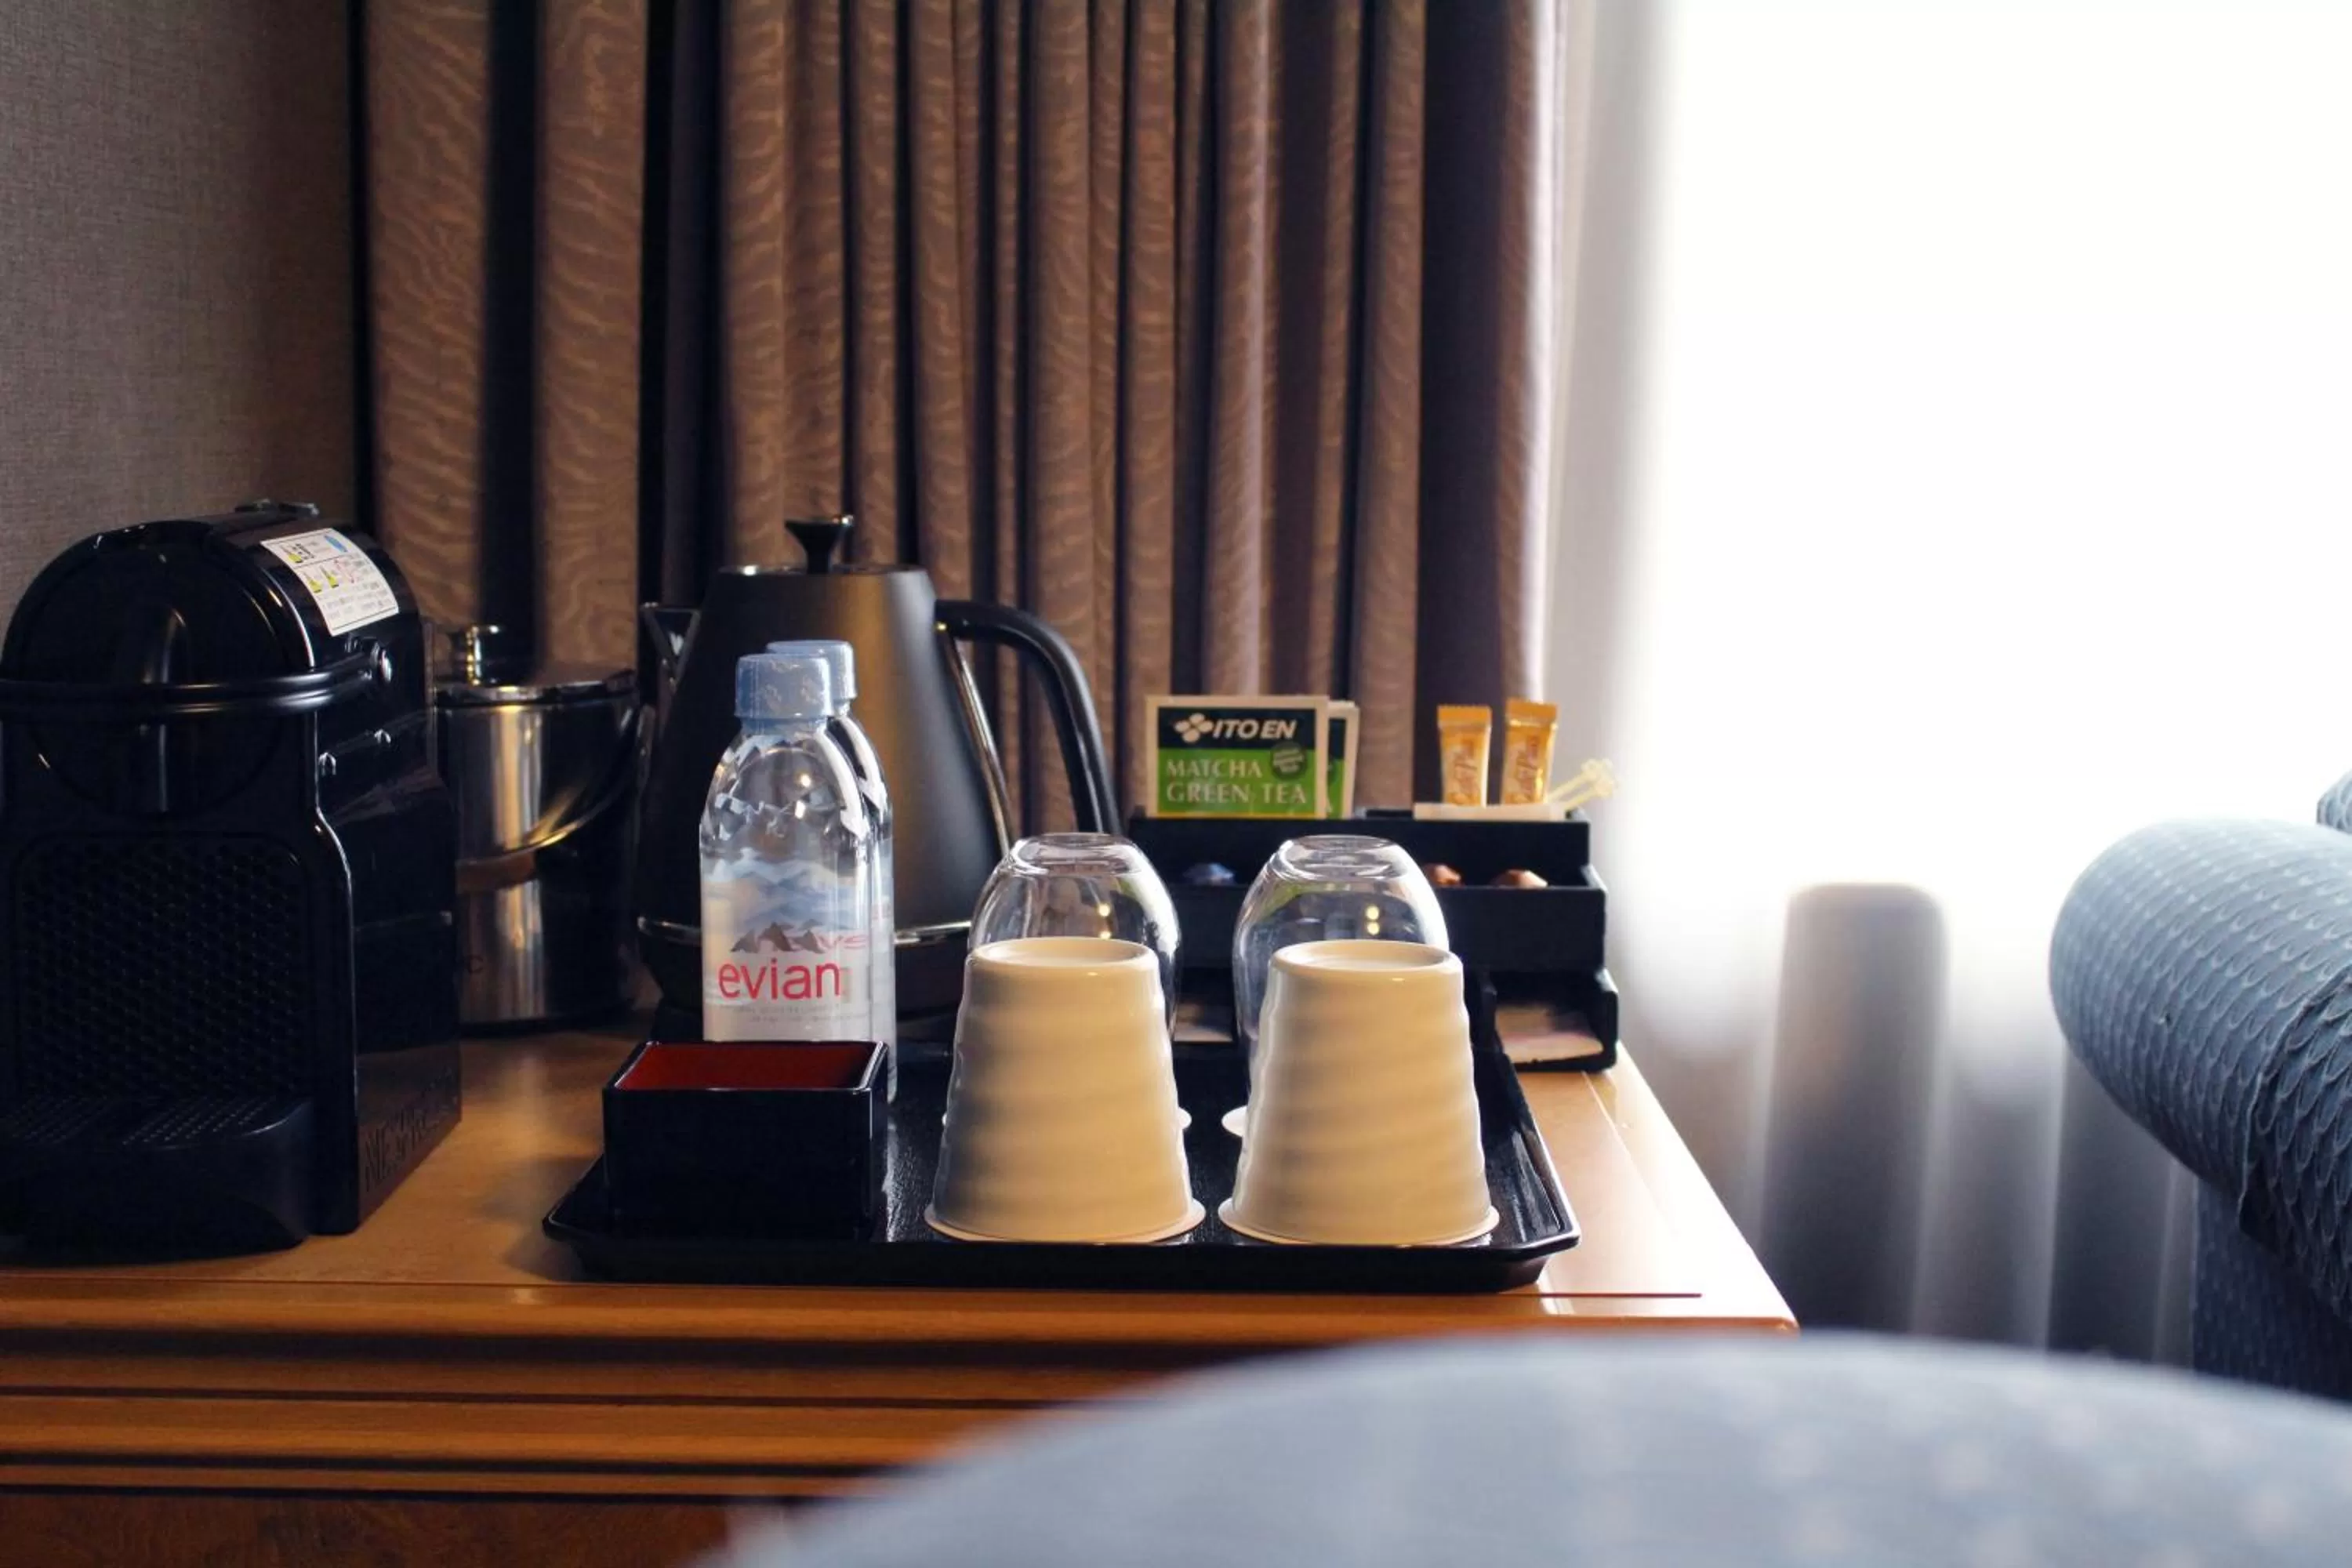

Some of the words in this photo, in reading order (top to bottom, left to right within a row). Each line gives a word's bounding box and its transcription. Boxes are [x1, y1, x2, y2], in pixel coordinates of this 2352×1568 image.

[1213, 719, 1258, 739] ITO
[1260, 720, 1297, 739] EN
[1166, 759, 1262, 778] MATCHA
[1166, 785, 1250, 804] GREEN
[1262, 784, 1306, 804] TEA
[718, 957, 840, 1000] evian
